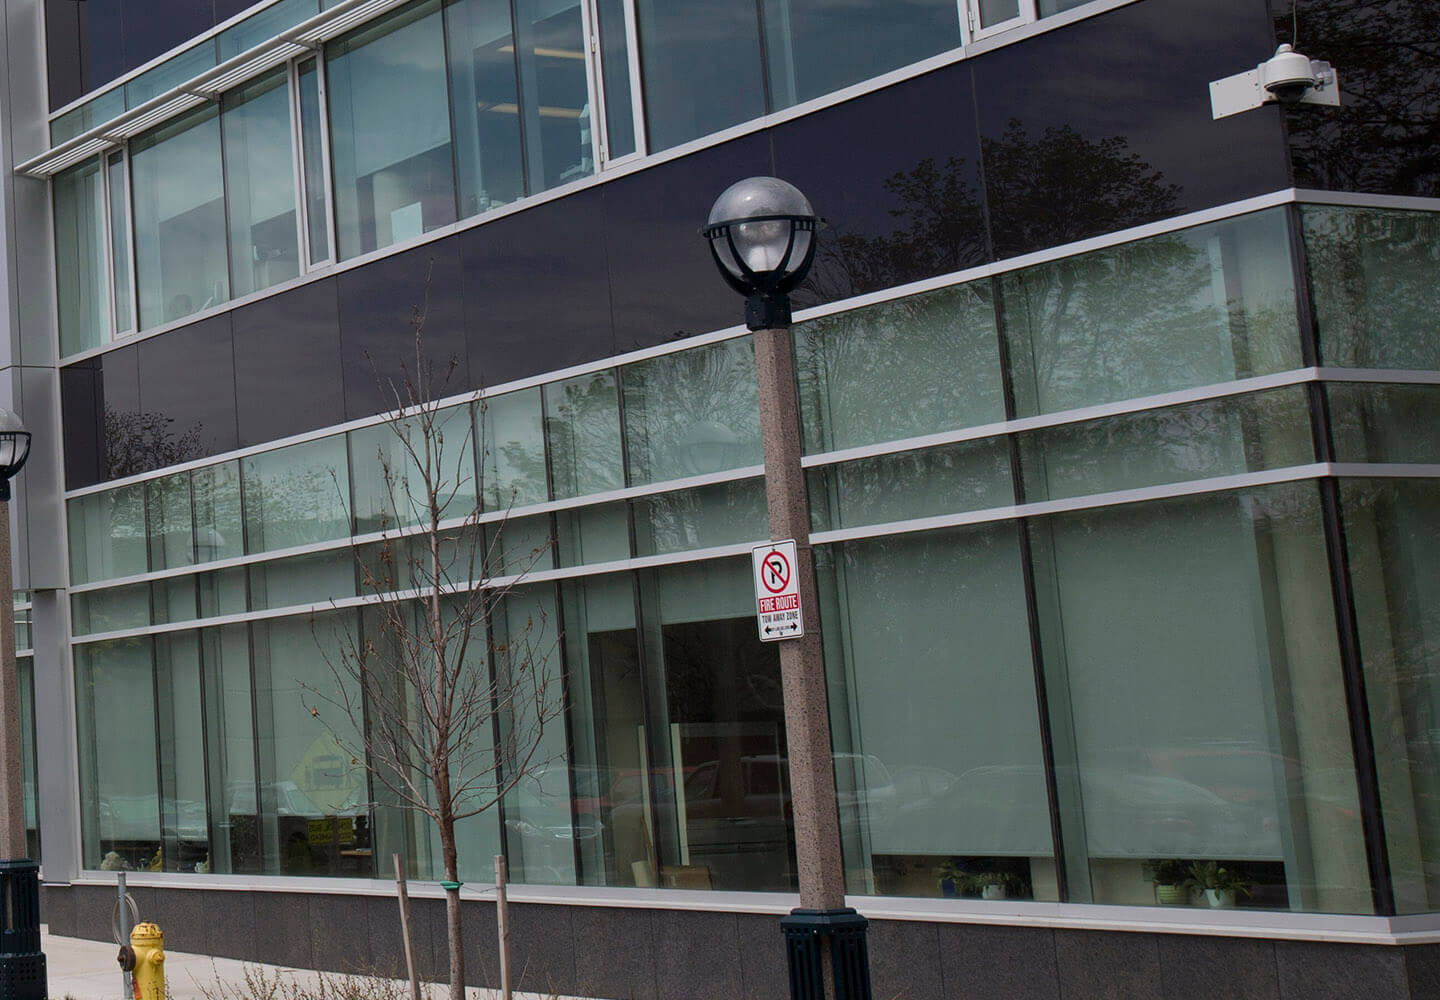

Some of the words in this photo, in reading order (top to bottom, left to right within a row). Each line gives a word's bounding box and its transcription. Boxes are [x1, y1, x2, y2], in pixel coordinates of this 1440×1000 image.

[760, 598, 775, 612] FIRE
[776, 595, 798, 610] ROUTE
[762, 614, 772, 623] TOW
[773, 612, 785, 622] AWAY
[786, 610, 799, 620] ZONE
